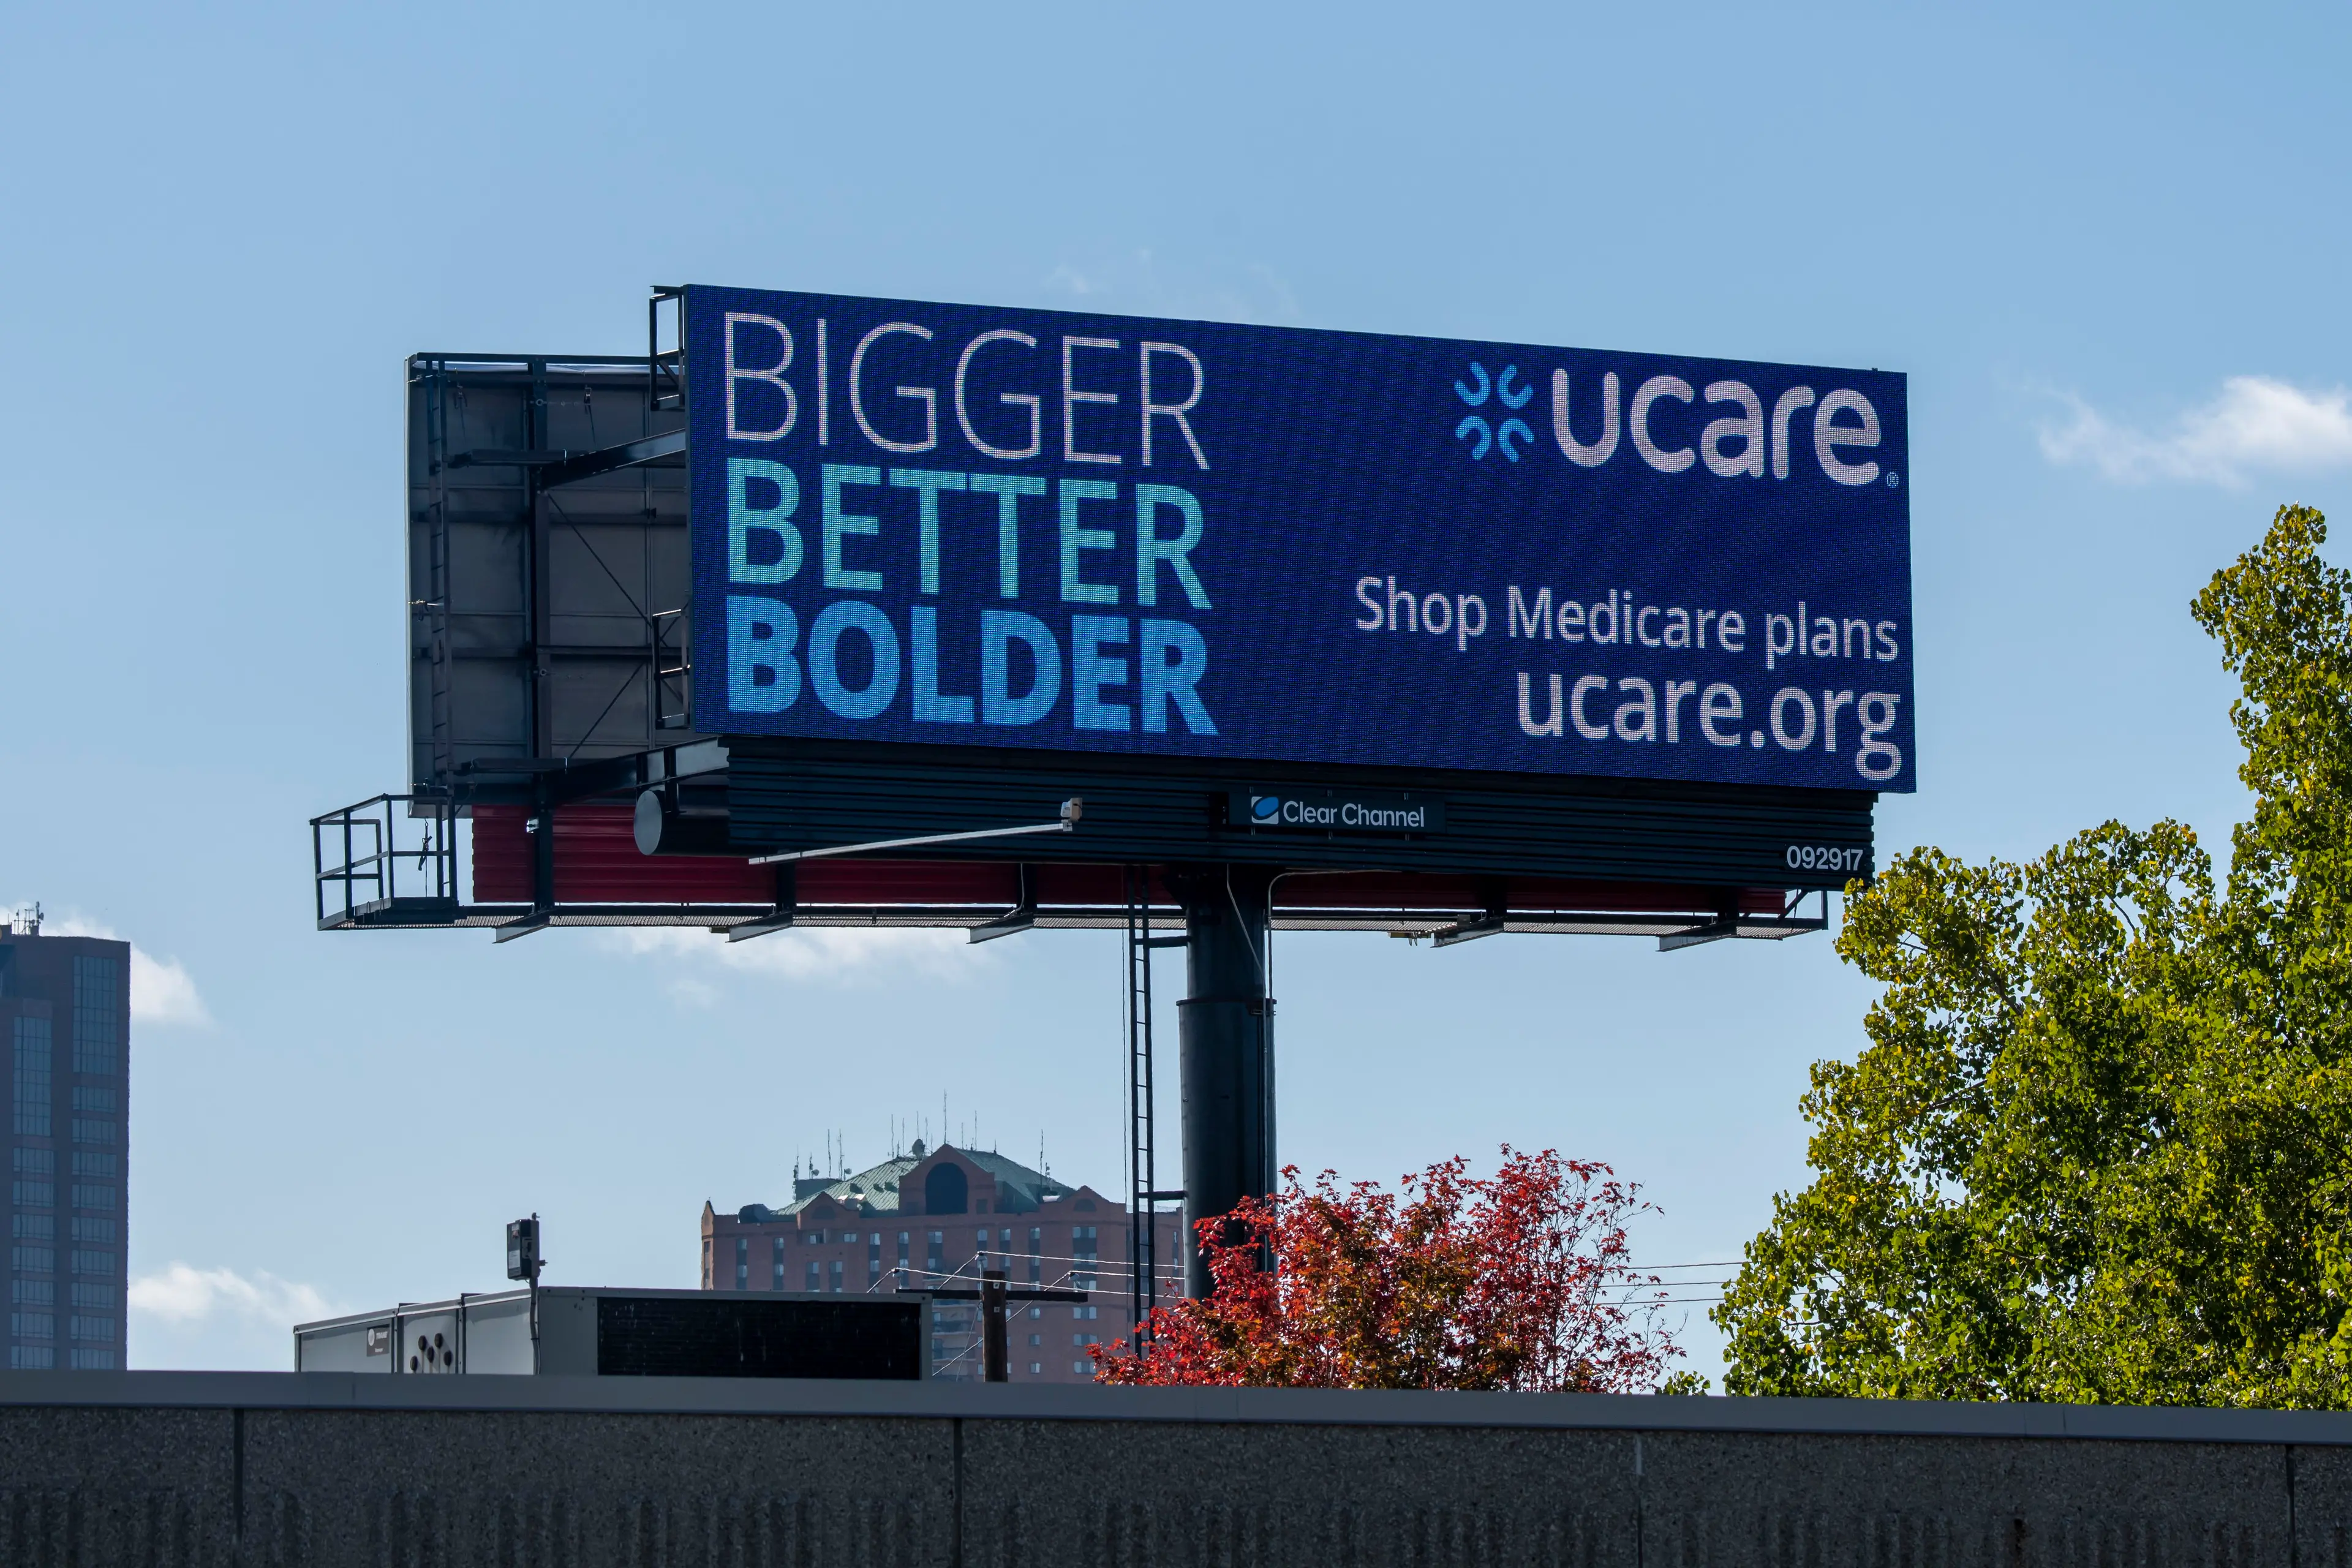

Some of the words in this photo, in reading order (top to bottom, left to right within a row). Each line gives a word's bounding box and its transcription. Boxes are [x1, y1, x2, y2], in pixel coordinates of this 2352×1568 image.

[725, 311, 1210, 470] BIGGER
[726, 457, 1213, 609] BETTER
[726, 595, 1218, 735] BOLDER
[1355, 575, 1488, 652] Shop
[1507, 585, 1746, 652] Medicare
[1765, 601, 1899, 670] plans
[1517, 671, 1902, 781] ucare.org
[1283, 801, 1337, 823] Clear
[1342, 803, 1424, 827] Channel
[1786, 845, 1863, 871] 092917
